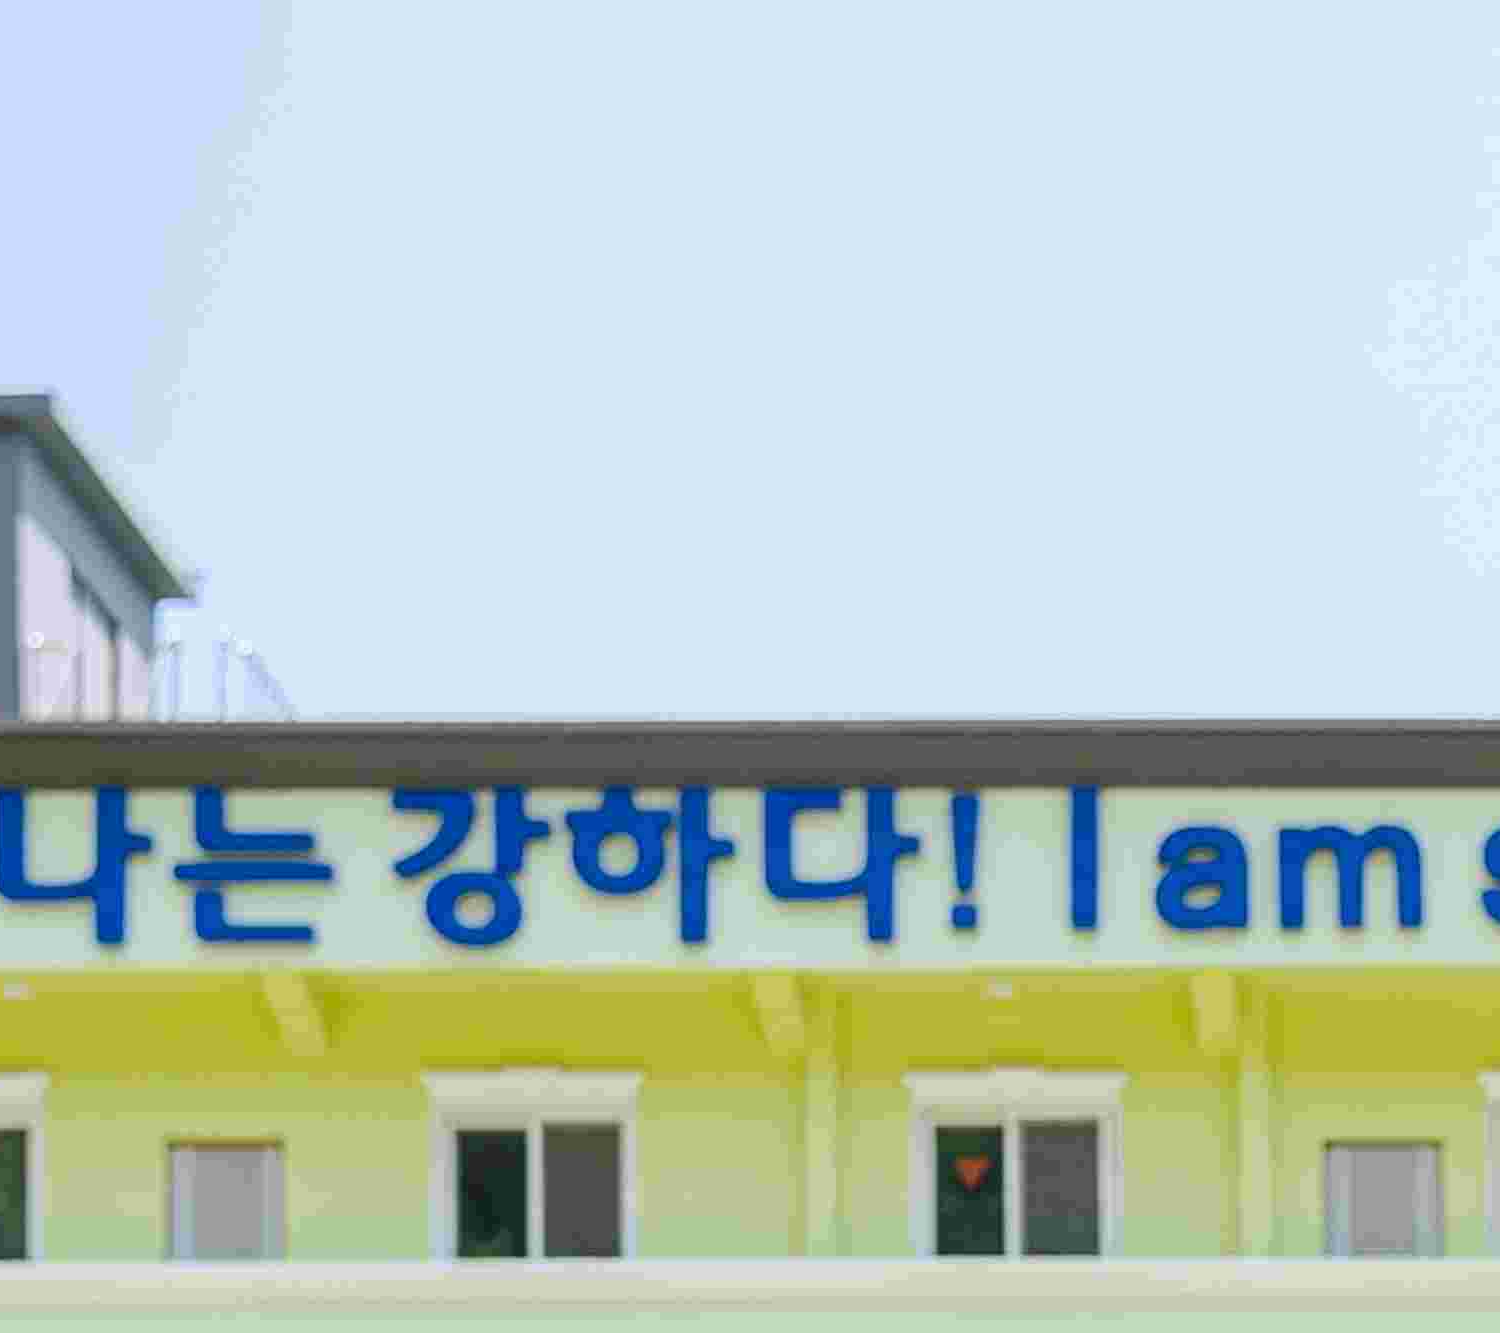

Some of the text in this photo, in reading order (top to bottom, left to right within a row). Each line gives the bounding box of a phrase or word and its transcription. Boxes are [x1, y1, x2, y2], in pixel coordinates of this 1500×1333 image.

[390, 784, 981, 948] 강하다!
[1069, 784, 1100, 930] I
[1154, 823, 1423, 931] am
